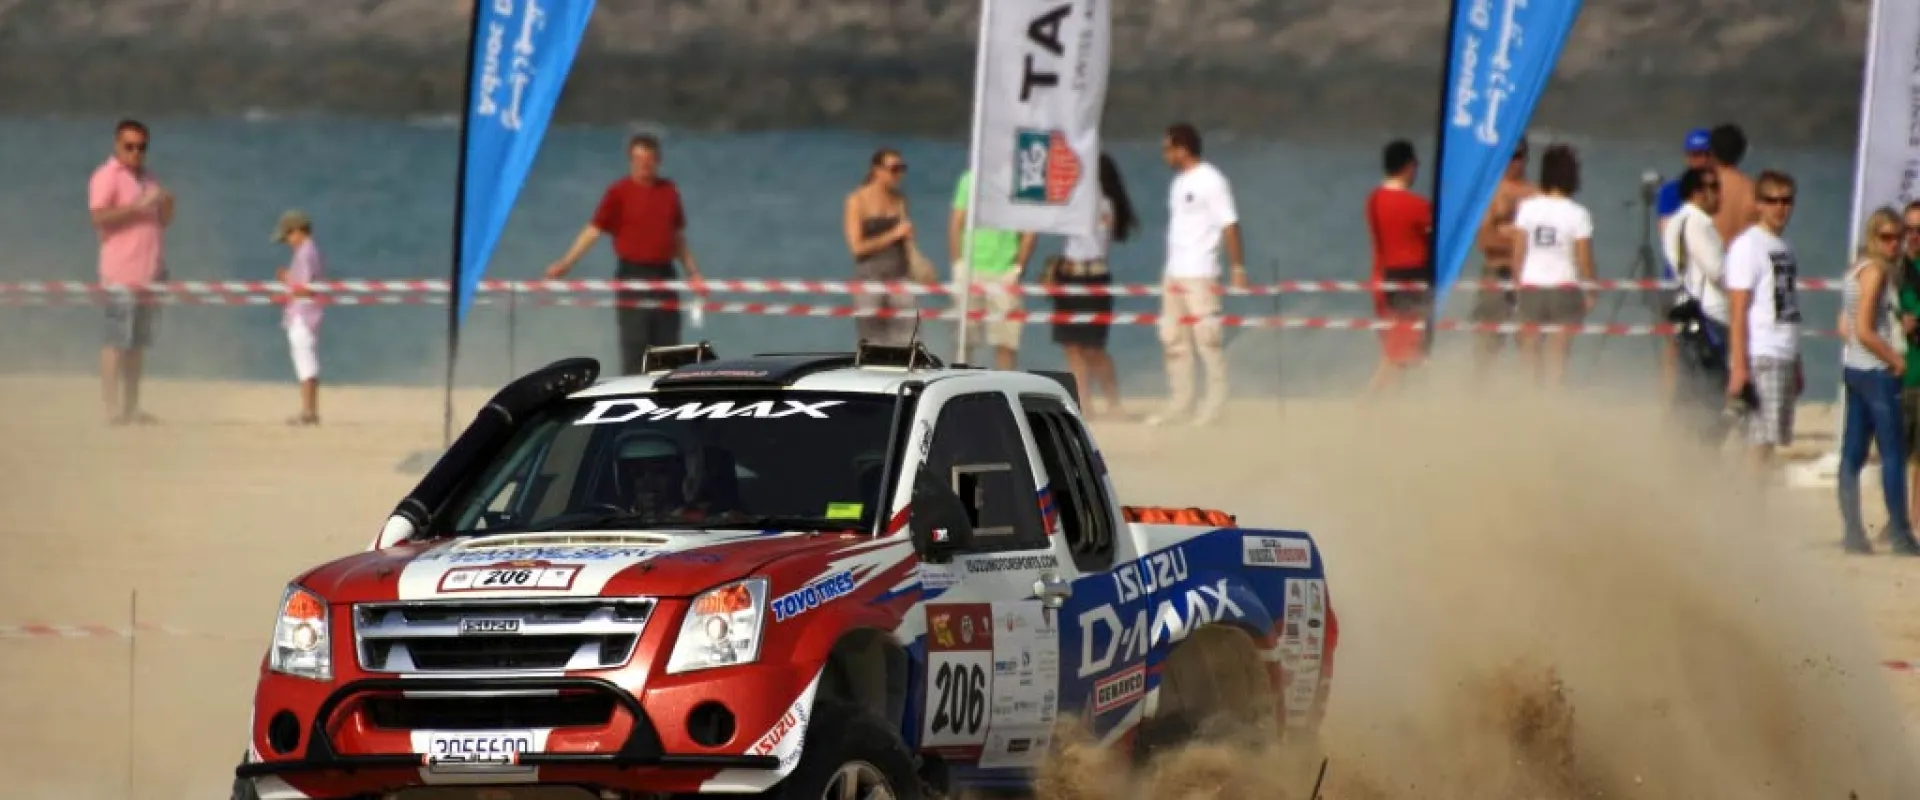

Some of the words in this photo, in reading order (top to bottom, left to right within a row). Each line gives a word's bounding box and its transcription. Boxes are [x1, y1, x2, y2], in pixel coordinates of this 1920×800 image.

[572, 397, 846, 426] D-MAX
[483, 569, 531, 586] 206
[773, 587, 818, 620] TOYO
[815, 571, 854, 600] TIRES
[1111, 546, 1188, 605] ISUZU
[462, 619, 519, 632] ISUZU
[931, 660, 986, 737] 206
[755, 710, 796, 756] ISUZU
